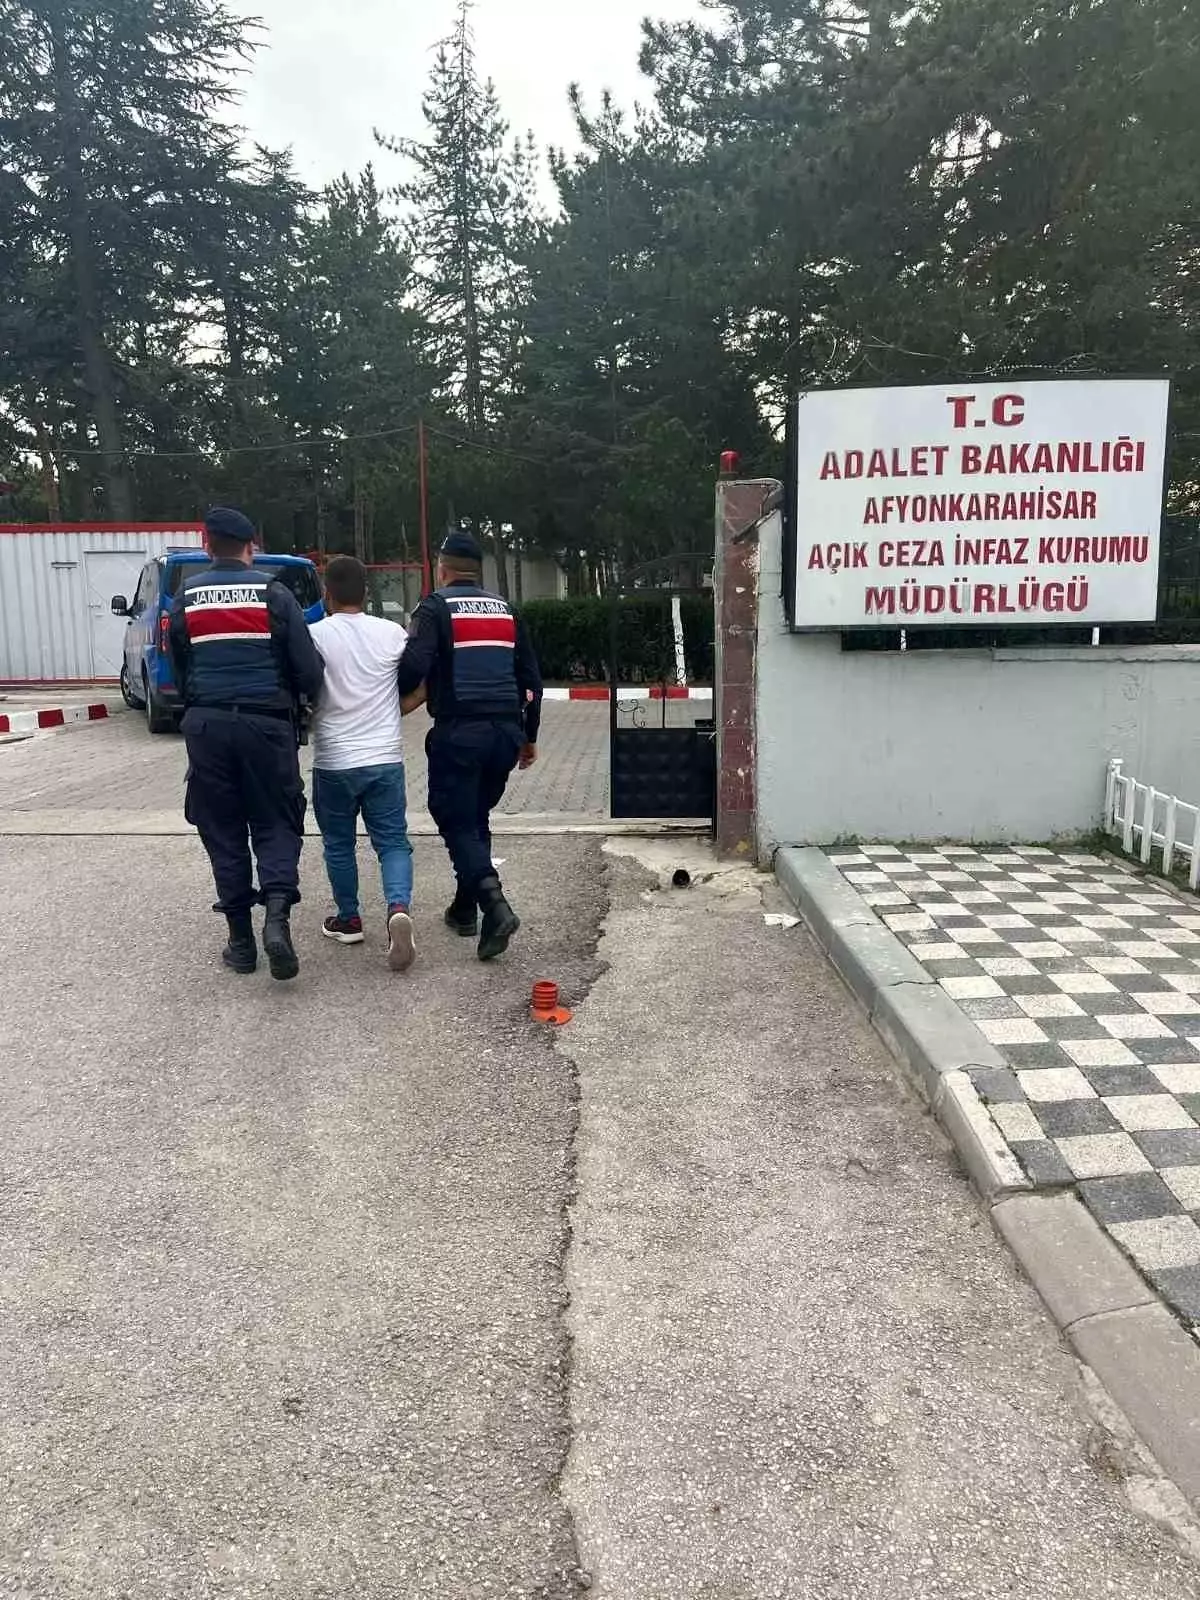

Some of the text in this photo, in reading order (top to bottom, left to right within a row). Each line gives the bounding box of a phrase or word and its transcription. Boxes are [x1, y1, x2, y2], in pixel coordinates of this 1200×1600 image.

[946, 393, 1025, 429] T.C
[819, 435, 1145, 481] ADALET BAKANLIĞI
[863, 485, 1097, 524] AFYONKARAHİSAR
[807, 533, 1149, 575] AÇIK CEZA İNFAZ KURUMU
[192, 589, 260, 605] JANDARMA
[456, 600, 508, 614] JANDARMA
